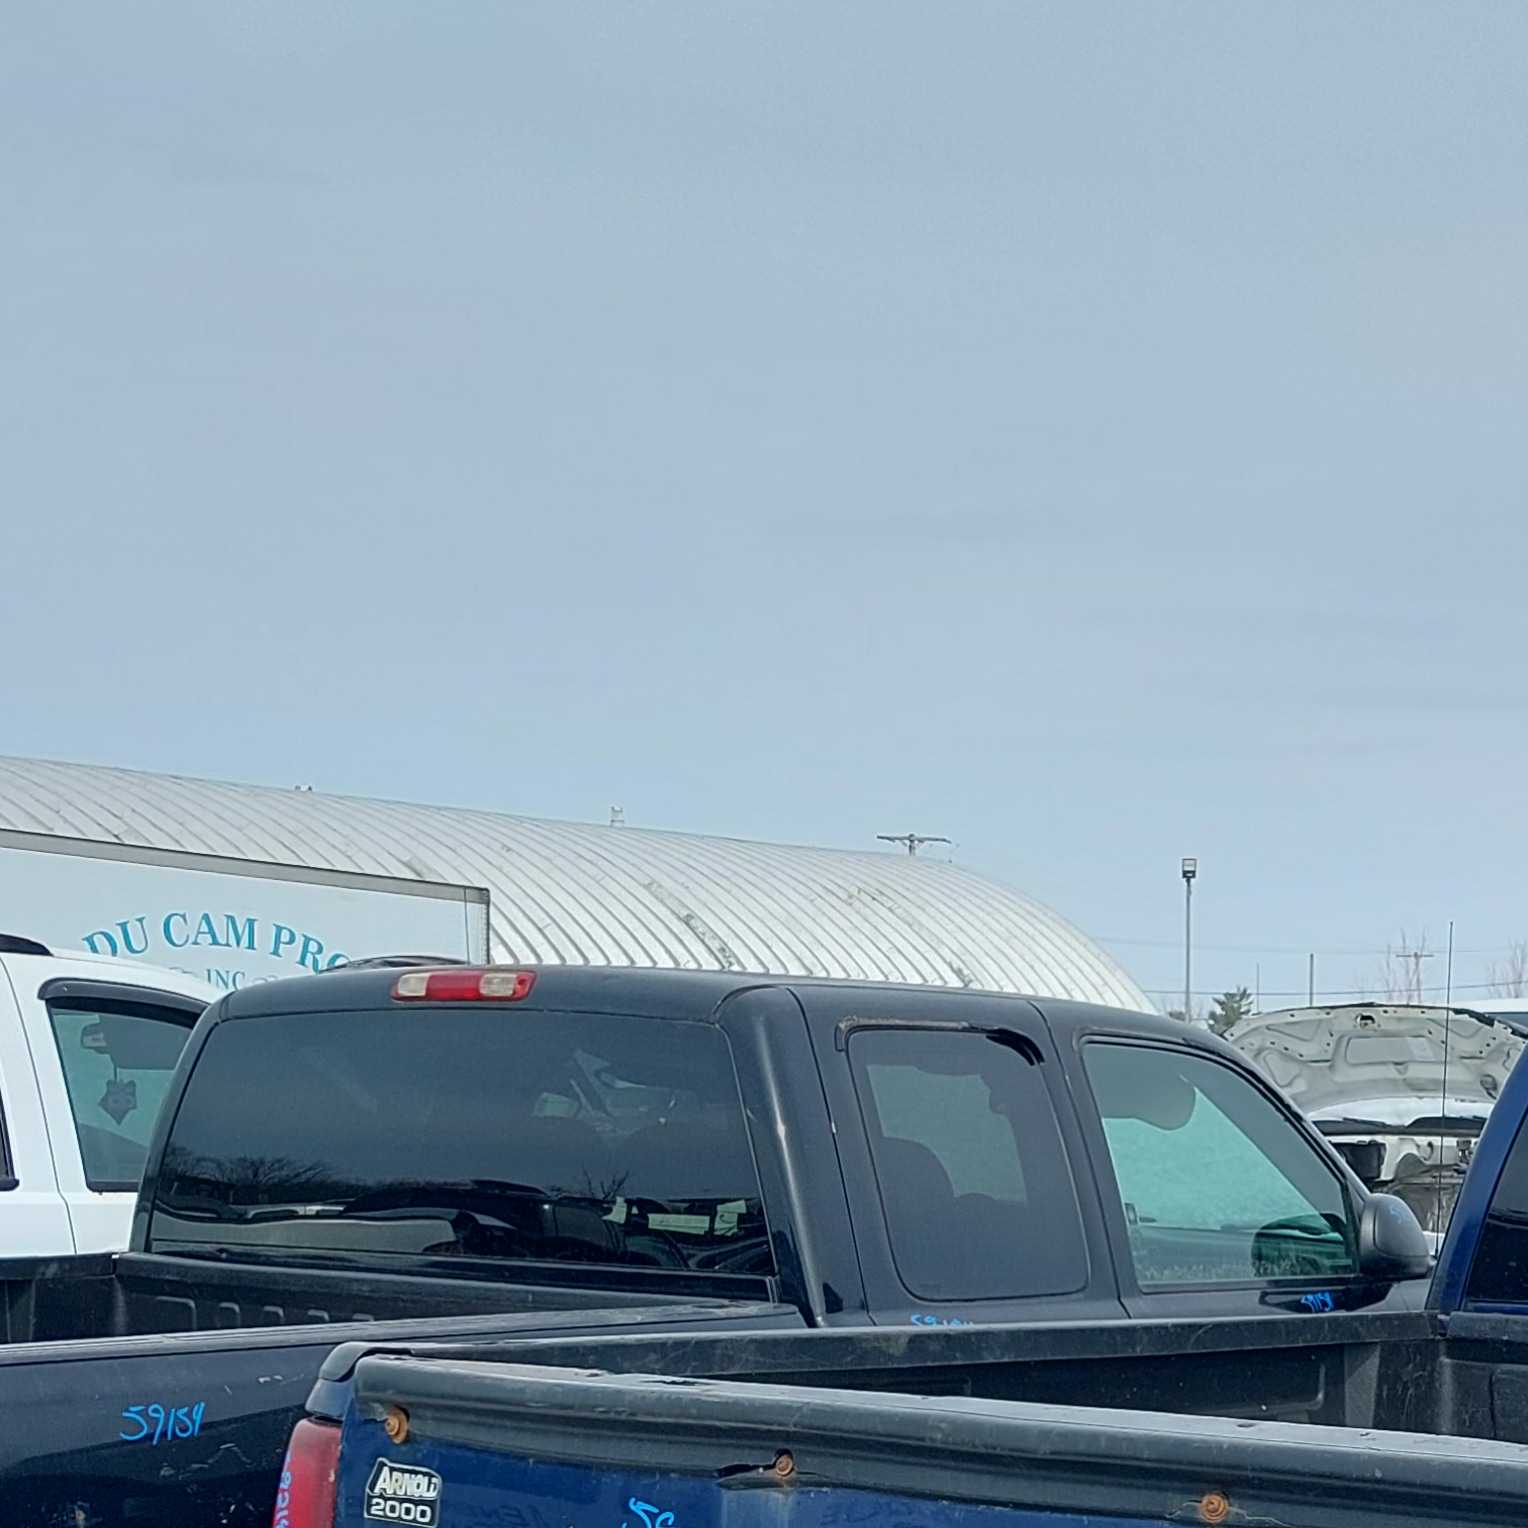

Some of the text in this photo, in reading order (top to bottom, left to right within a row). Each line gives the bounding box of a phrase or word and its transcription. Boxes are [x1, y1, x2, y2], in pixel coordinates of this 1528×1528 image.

[82, 916, 149, 957] DU
[162, 912, 258, 950] CAM
[373, 1466, 440, 1498] ARNOLD
[370, 1498, 431, 1523] 2000
